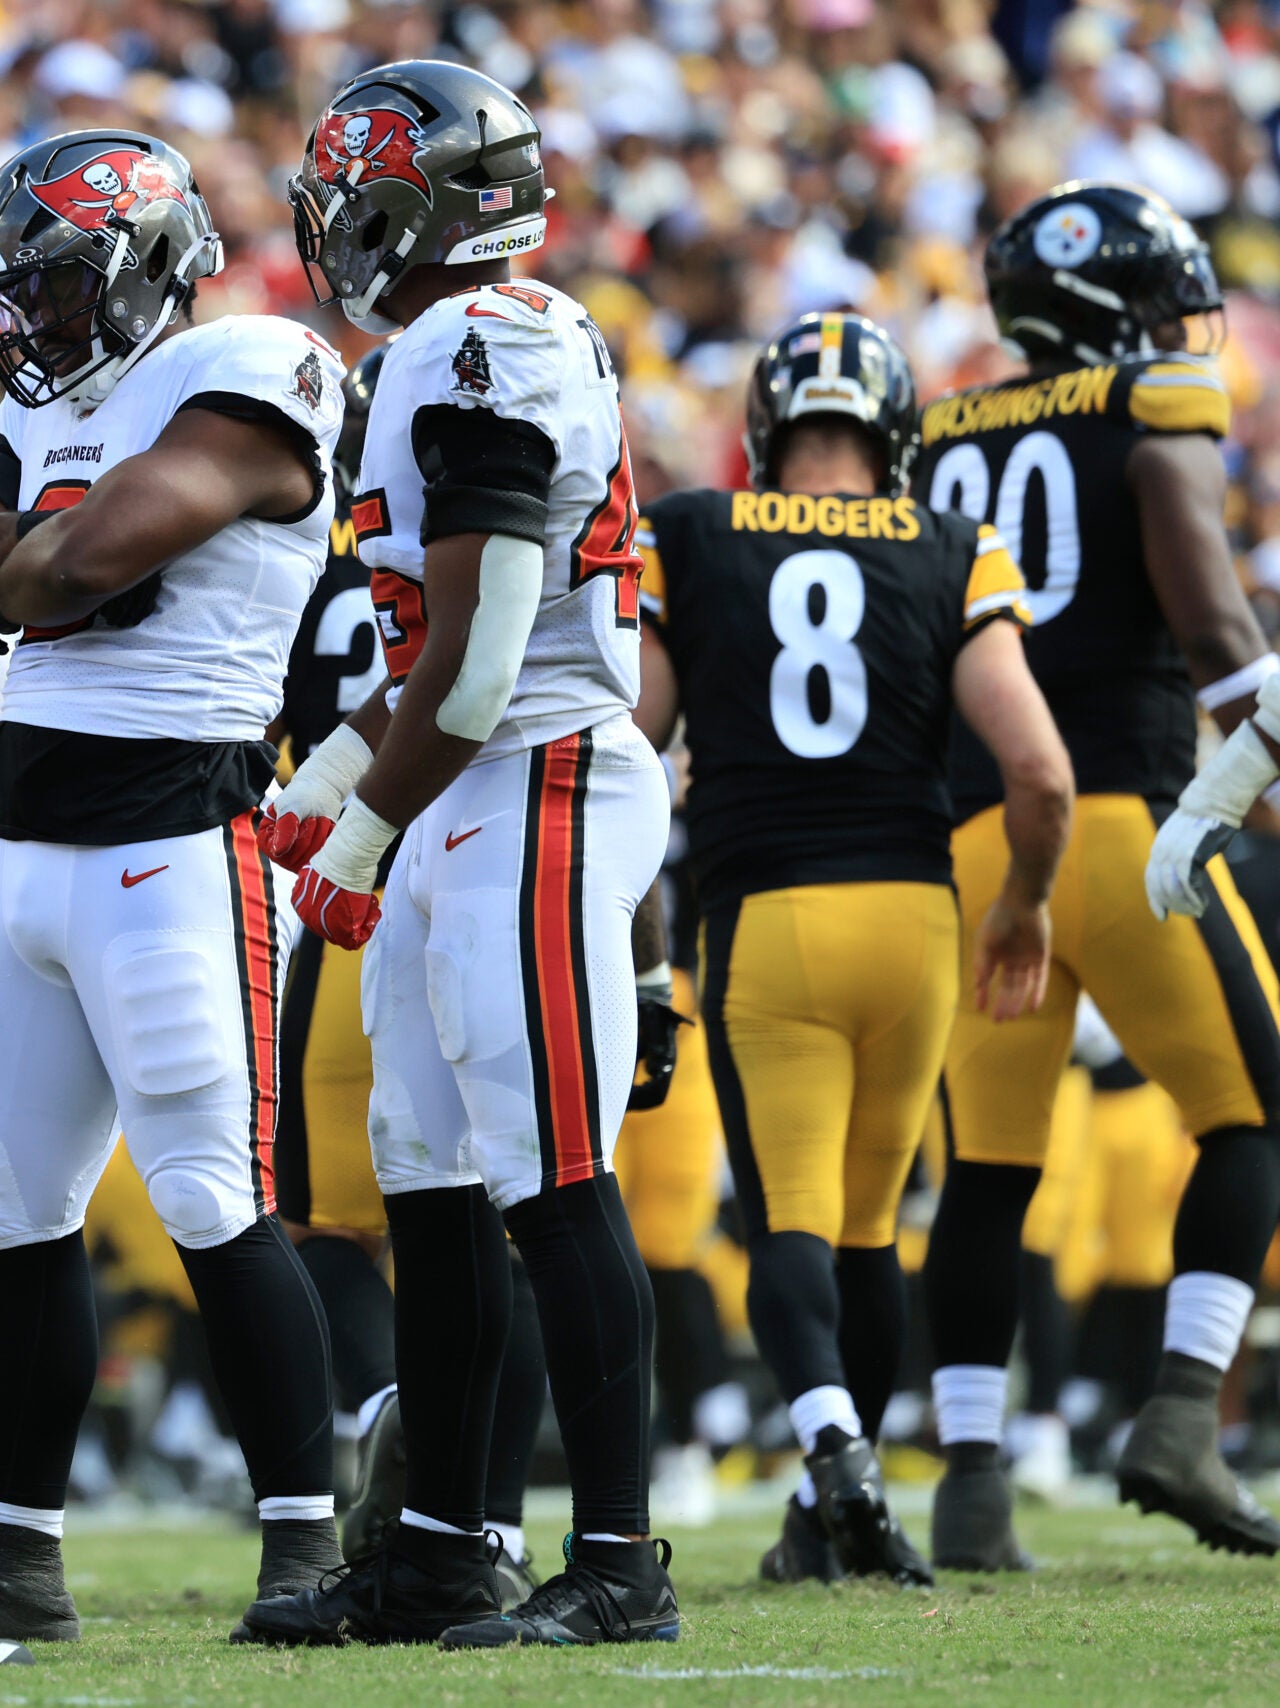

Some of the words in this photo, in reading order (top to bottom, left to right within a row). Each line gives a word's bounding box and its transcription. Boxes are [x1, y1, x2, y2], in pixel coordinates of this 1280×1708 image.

[12, 254, 44, 266] OAKLEY
[472, 235, 531, 255] CHOOSE
[922, 363, 1118, 448] WASHINGTON
[42, 442, 105, 468] BUCCANEERS
[731, 490, 920, 541] RODGERS
[768, 548, 868, 759] 8
